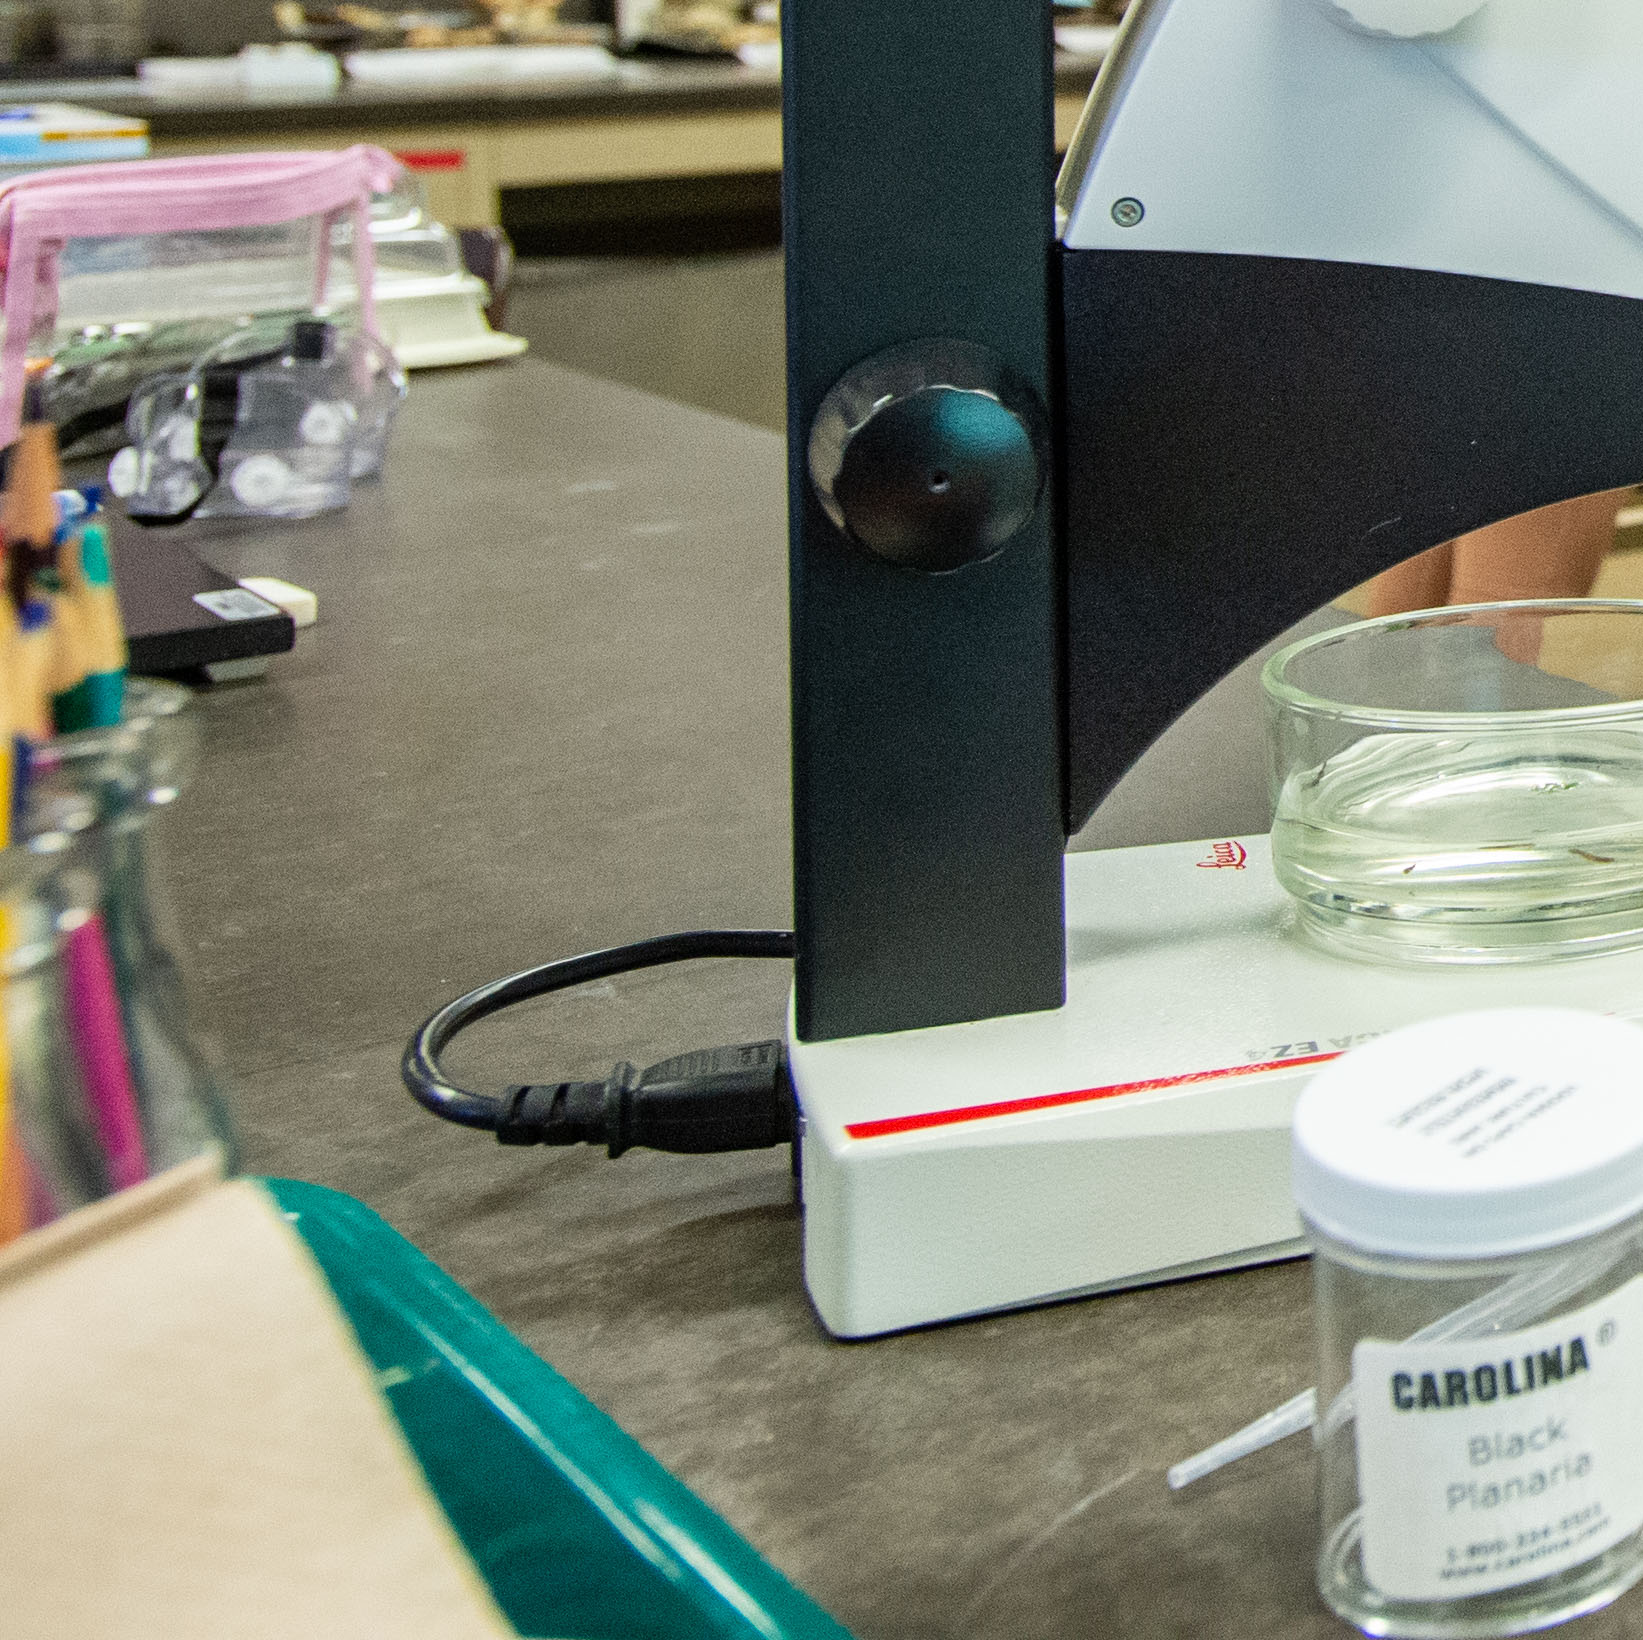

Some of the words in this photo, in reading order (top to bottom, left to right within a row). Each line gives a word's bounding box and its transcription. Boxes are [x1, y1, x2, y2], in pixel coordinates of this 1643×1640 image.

[1391, 1336, 1590, 1411] CAROLINA
[1468, 1417, 1566, 1466] Black
[1446, 1453, 1592, 1512] Planaria
